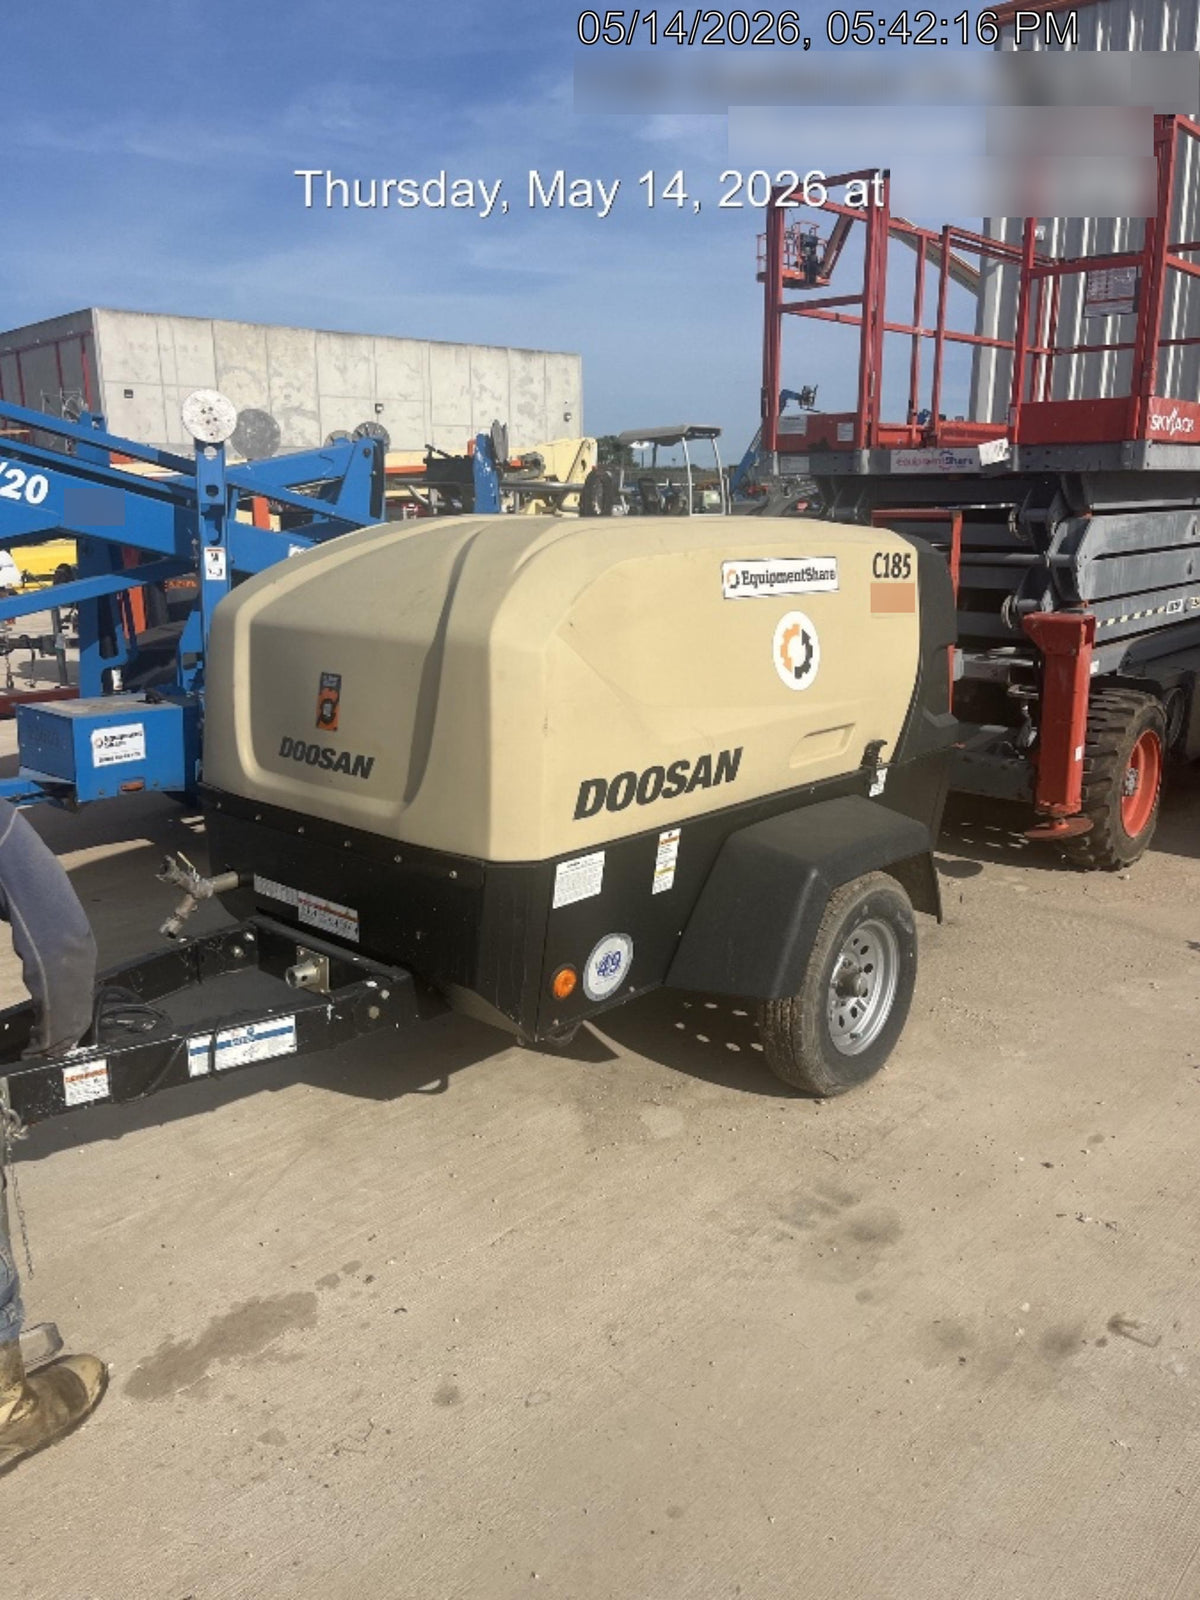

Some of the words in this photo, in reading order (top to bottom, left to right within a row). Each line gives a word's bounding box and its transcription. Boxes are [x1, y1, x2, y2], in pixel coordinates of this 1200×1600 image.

[741, 566, 836, 589] EquipmentShare
[872, 552, 912, 580] C185
[279, 736, 375, 779] DOOSAN
[573, 747, 744, 820] DOOSAN
